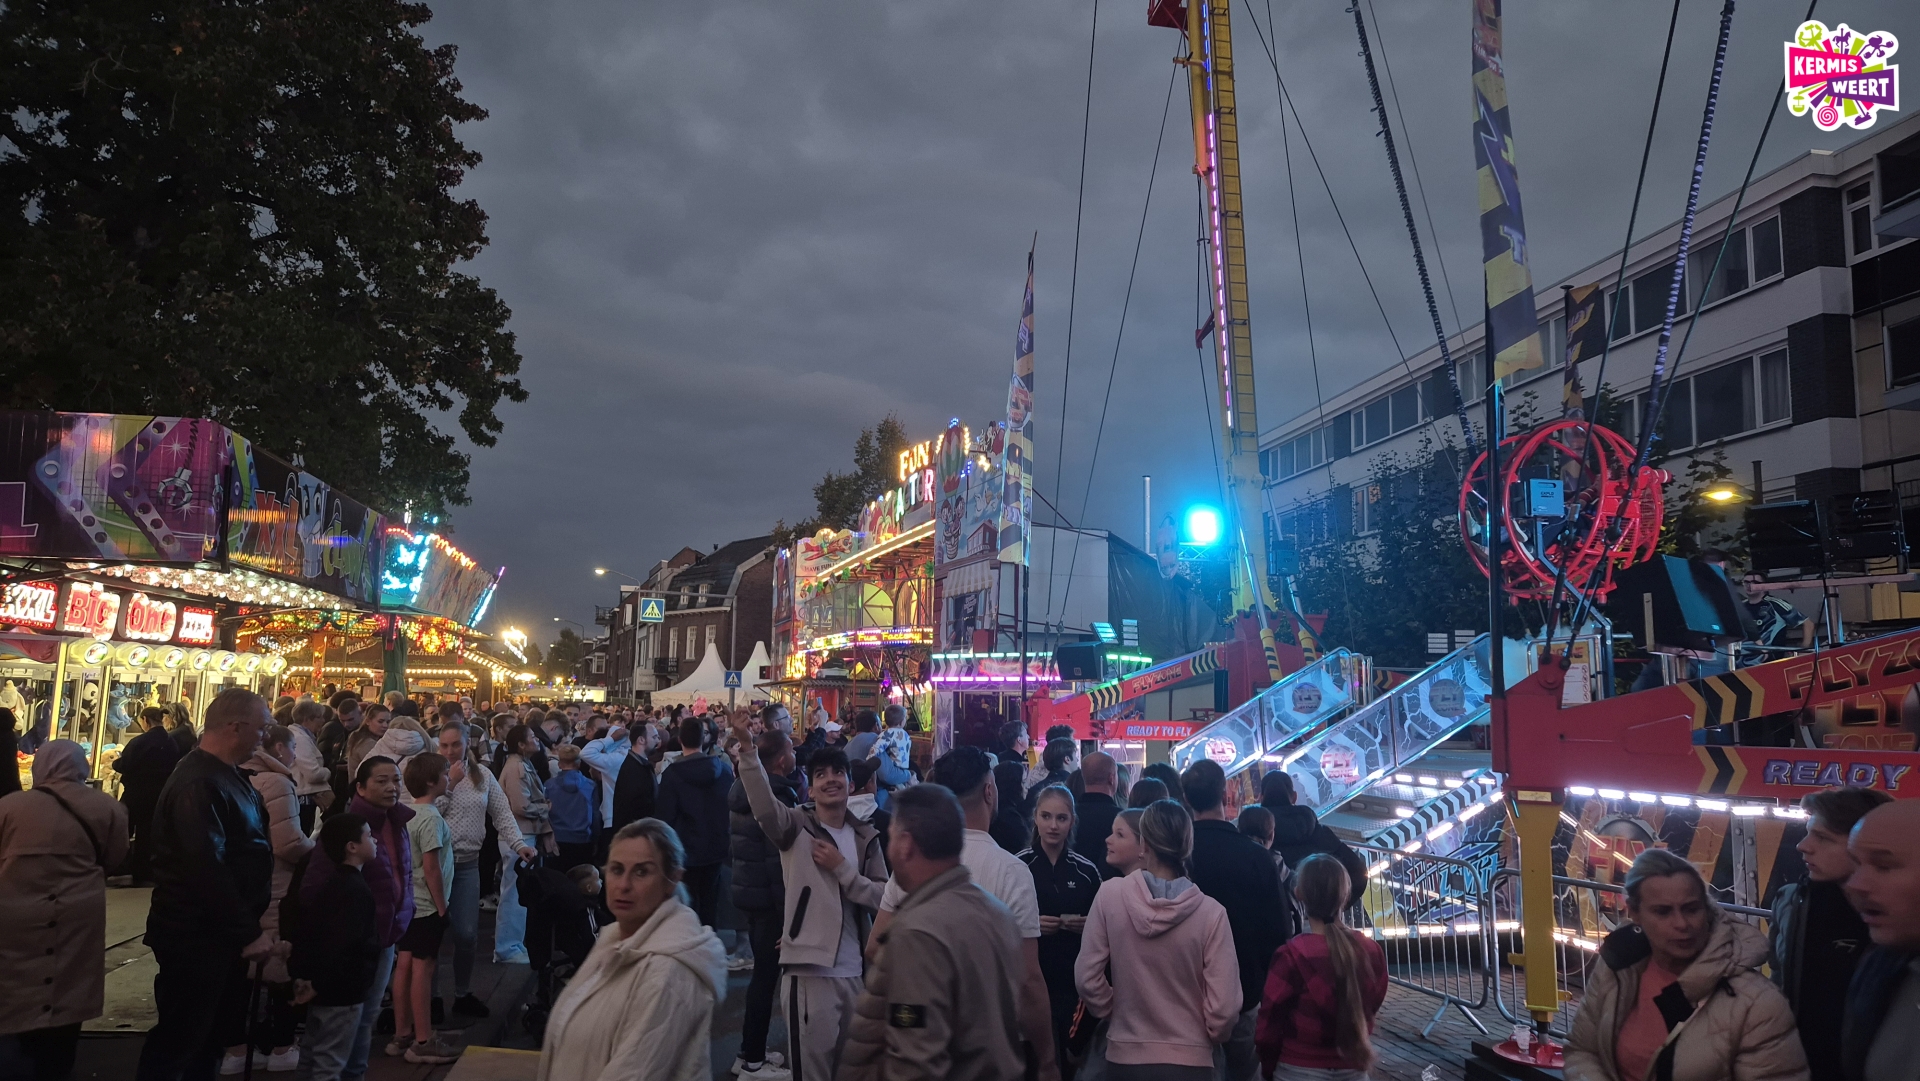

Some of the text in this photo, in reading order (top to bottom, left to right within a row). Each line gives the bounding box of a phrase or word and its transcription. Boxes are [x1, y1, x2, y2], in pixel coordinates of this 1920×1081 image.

[899, 441, 932, 482] FUN
[254, 488, 299, 561] XXL
[1131, 664, 1182, 693] FLYZONE
[1126, 725, 1193, 737] READY TO FLY
[1322, 752, 1355, 769] FLY
[1328, 769, 1353, 779] ZONE
[1763, 759, 1911, 790] READY
